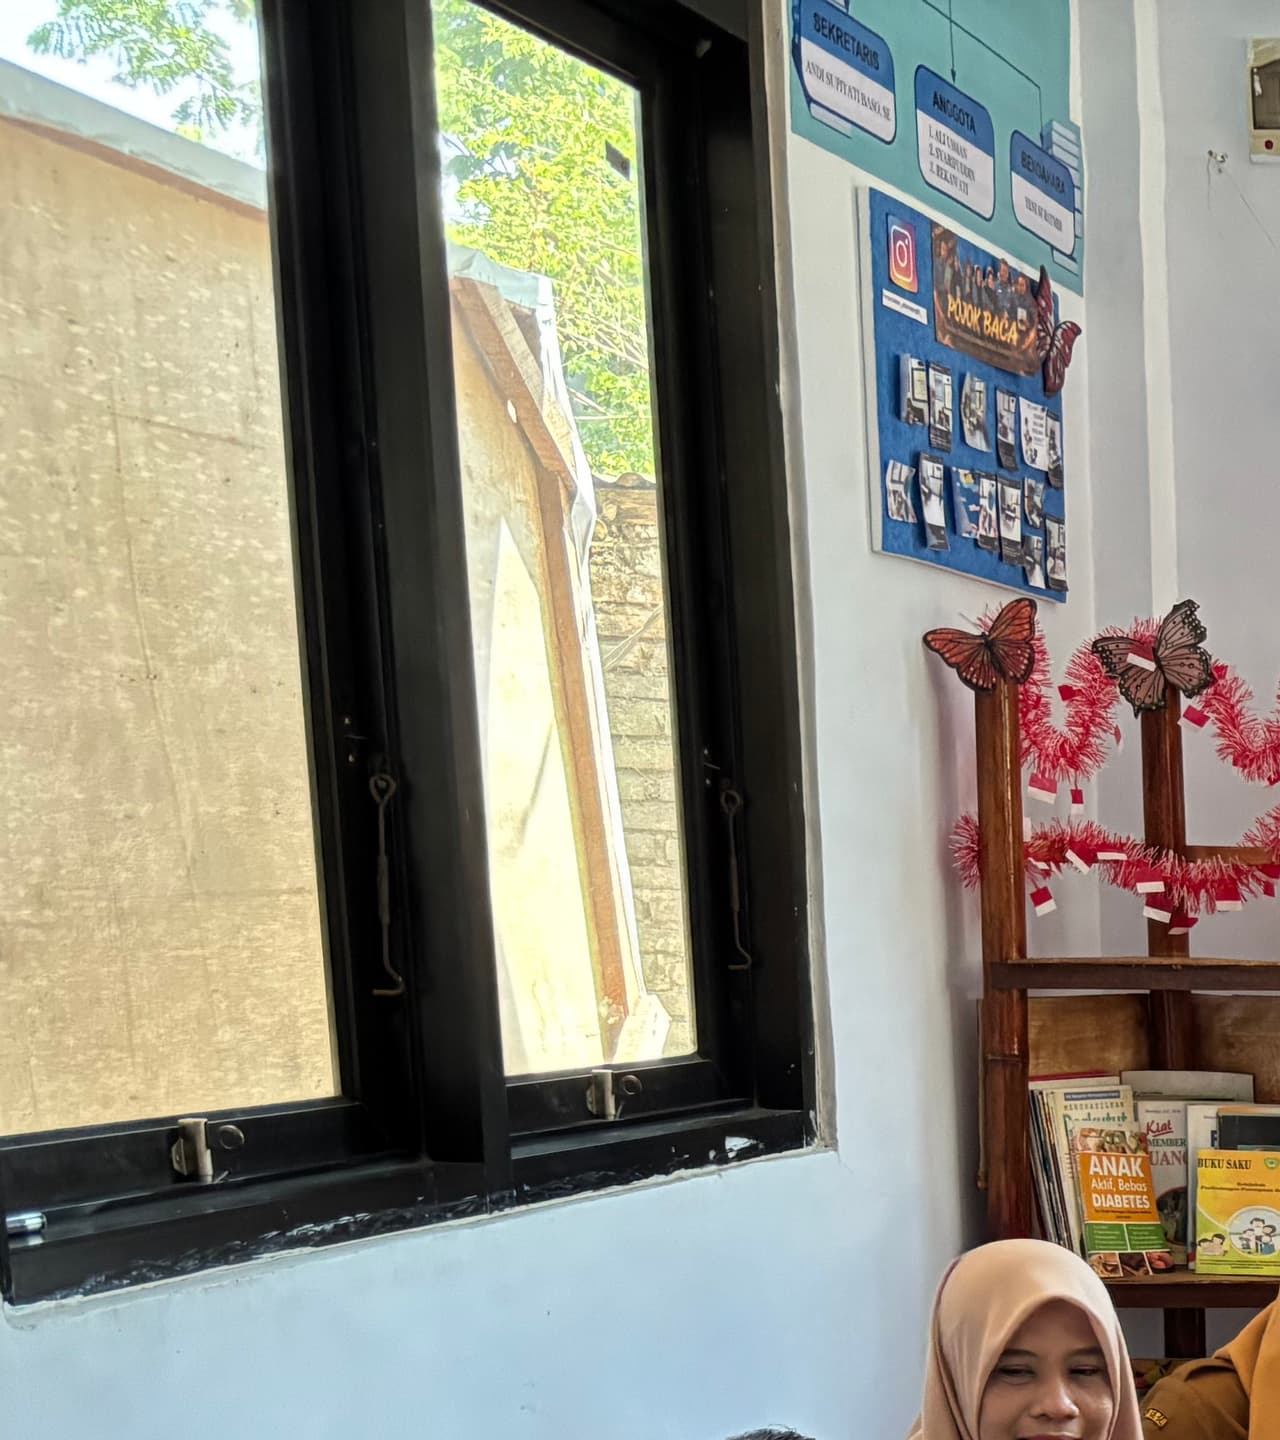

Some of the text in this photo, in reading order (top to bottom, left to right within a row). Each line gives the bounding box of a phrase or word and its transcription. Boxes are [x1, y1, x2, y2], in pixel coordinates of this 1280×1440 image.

[813, 12, 880, 71] SEKRETARIS
[932, 91, 976, 135] ANGGOTA
[947, 293, 980, 331] POJOK
[983, 311, 1018, 346] BACA
[1146, 1120, 1173, 1136] Kiat
[1089, 1155, 1144, 1177] ANAK
[1197, 1158, 1252, 1170] BUKU SAKU
[1091, 1178, 1148, 1192] Aktif, Bebas
[1092, 1193, 1150, 1209] DIABETES
